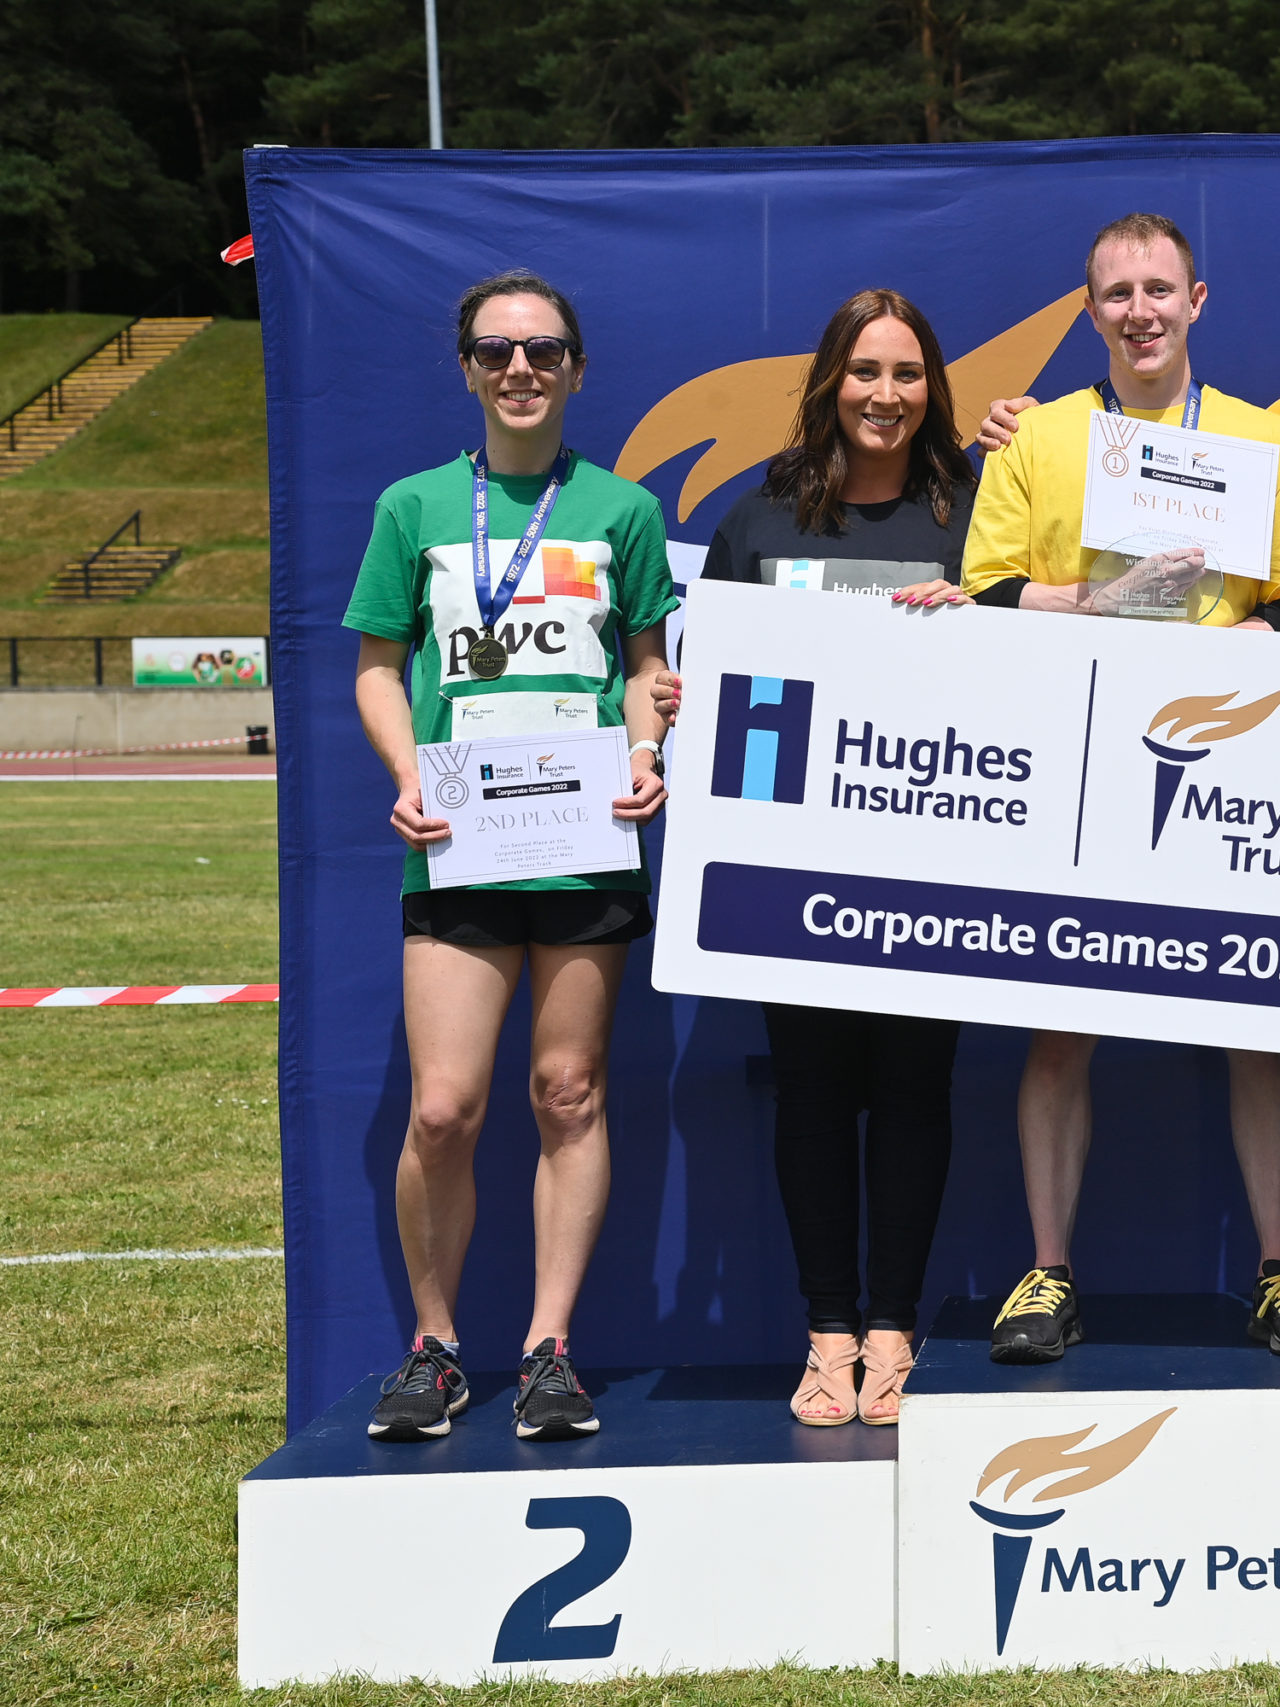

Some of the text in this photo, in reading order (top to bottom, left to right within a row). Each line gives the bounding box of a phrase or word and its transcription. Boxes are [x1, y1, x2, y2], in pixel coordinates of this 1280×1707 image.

[1156, 451, 1179, 461] Hughes
[477, 465, 486, 483] 1972
[1152, 471, 1215, 489] Corporate Games 2022
[1210, 465, 1225, 473] Peters
[477, 491, 485, 510] 2022
[1166, 498, 1225, 523] PLACE
[477, 511, 486, 529] 50th
[506, 564, 521, 583] 1972
[518, 539, 533, 558] 2022
[527, 521, 540, 539] 50th
[535, 476, 559, 522] Anniversary
[477, 530, 487, 577] Anniversary
[447, 620, 567, 677] pwc
[834, 718, 1033, 787] Hughes
[496, 766, 524, 776] Hughes
[447, 786, 458, 800] 2
[496, 783, 569, 797] Corporate Games 2022
[831, 773, 1029, 827] Insurance
[475, 807, 589, 832] 2ND PLACE
[802, 893, 1036, 959] Corporate
[1046, 917, 1209, 973] Games
[492, 1495, 632, 1663] 2
[1041, 1547, 1186, 1607] Mary
